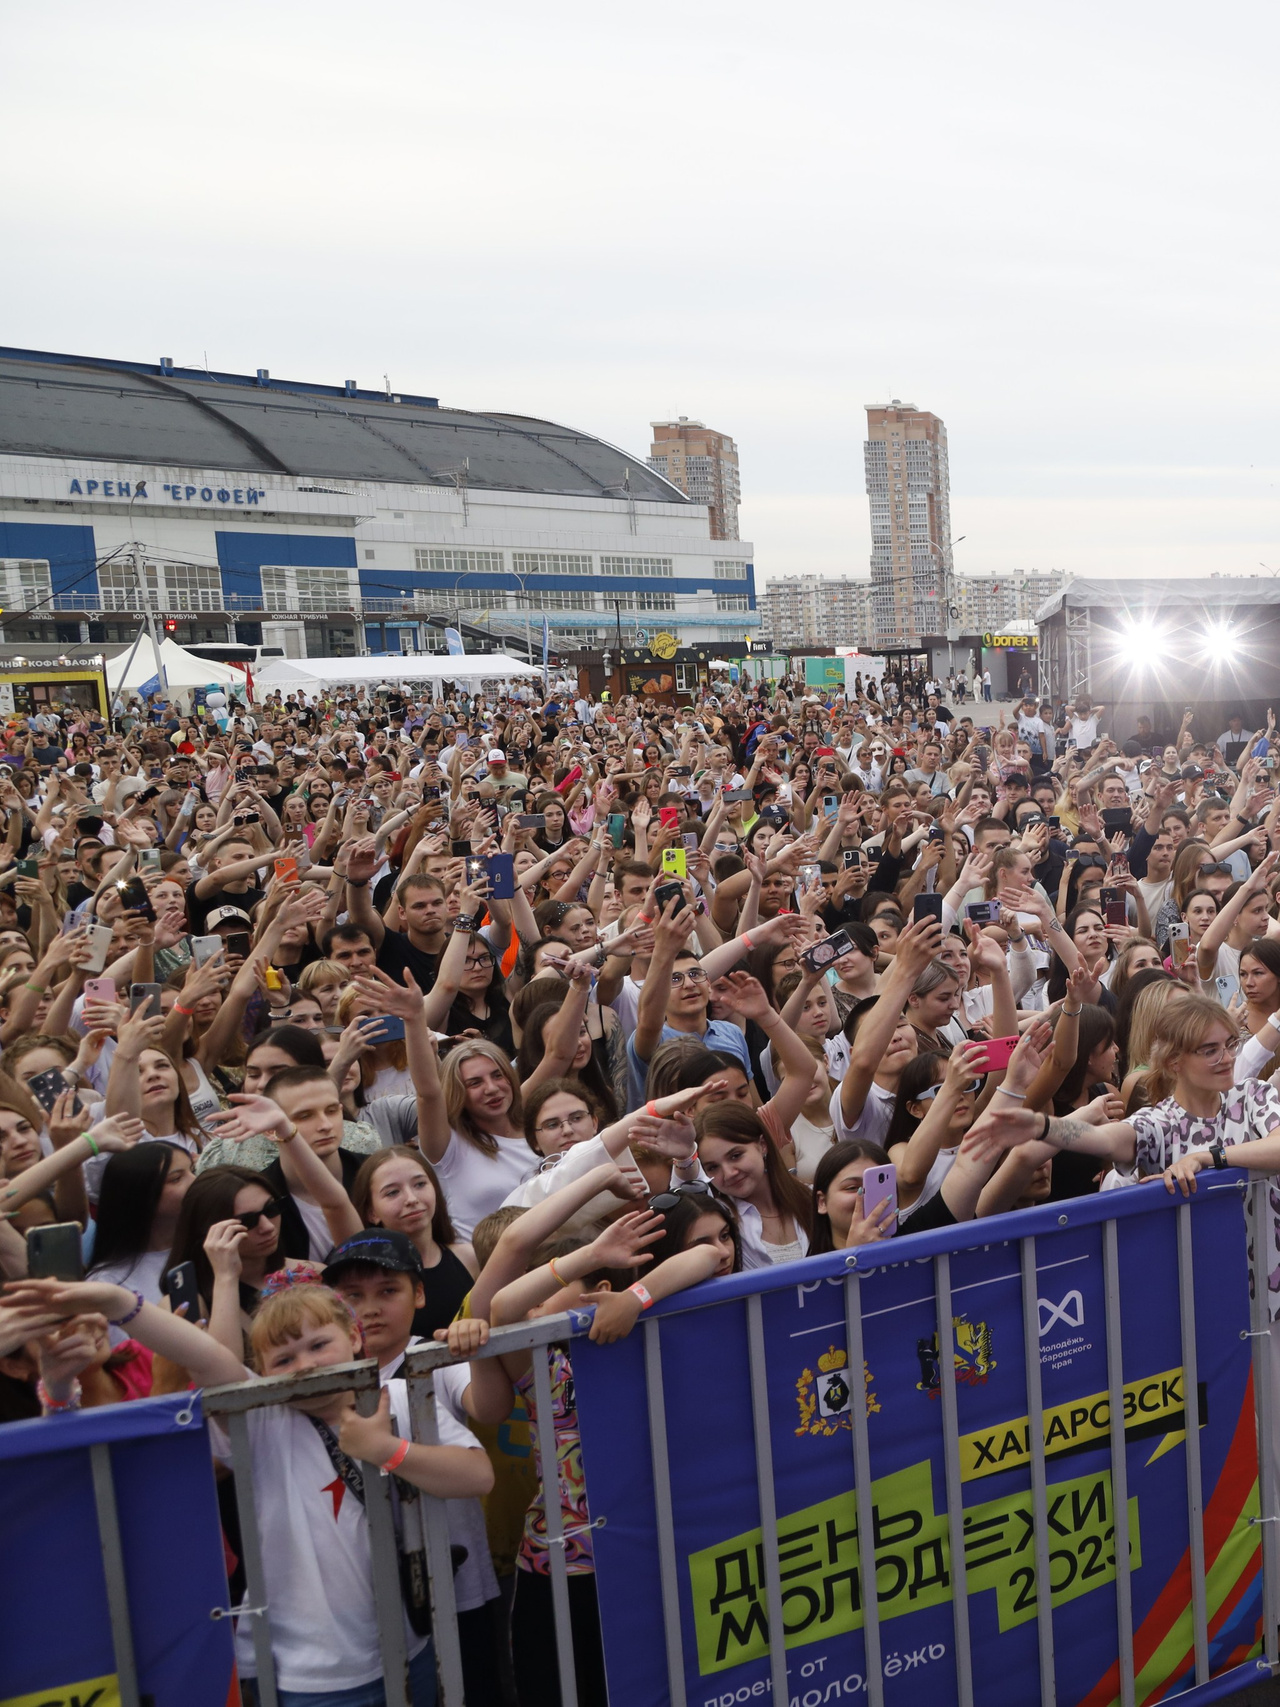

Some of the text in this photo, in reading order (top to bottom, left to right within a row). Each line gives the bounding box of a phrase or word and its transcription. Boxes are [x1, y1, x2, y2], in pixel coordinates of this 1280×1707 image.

[70, 478, 266, 505] АРЕНА "ЕРОФЕЙ"
[28, 660, 59, 668] КОФЕ
[1039, 1343, 1093, 1364] баровского
[1051, 1358, 1073, 1370] края
[708, 1504, 924, 1617] ДЕНЬ
[799, 1656, 829, 1679] от
